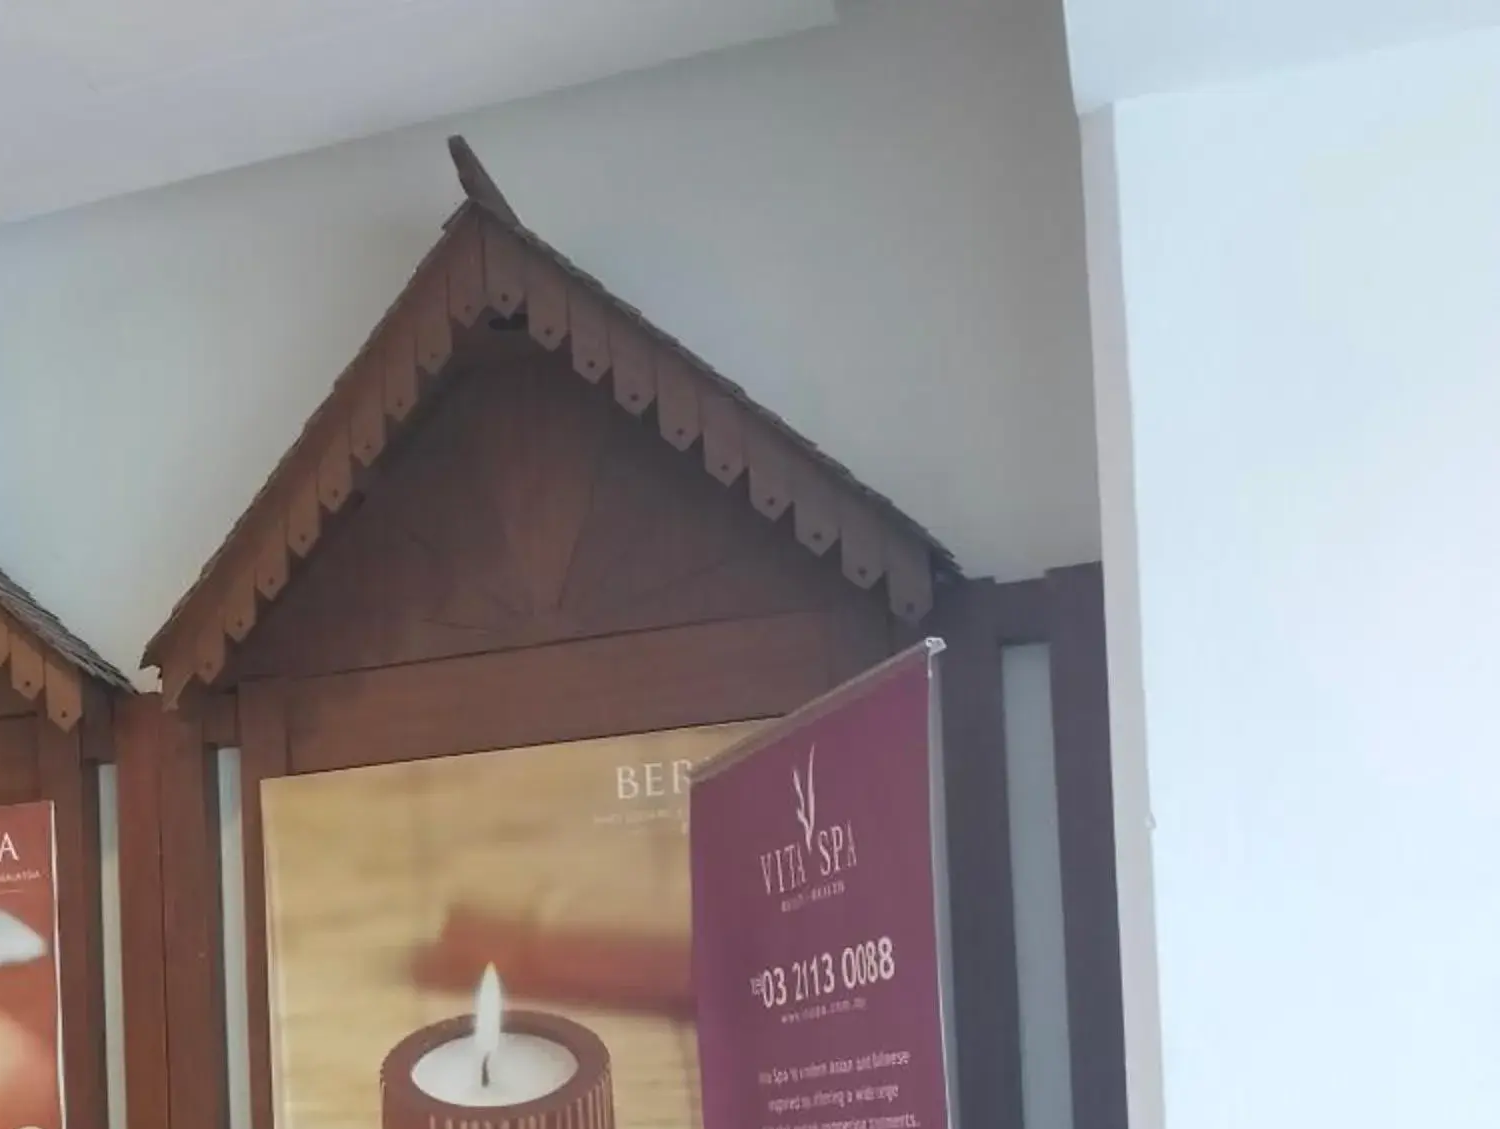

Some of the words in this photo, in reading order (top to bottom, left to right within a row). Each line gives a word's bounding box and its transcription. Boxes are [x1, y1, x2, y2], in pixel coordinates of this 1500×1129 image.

[760, 842, 806, 896] VITA
[818, 820, 857, 876] SPA
[762, 966, 788, 1009] 03
[791, 951, 835, 1001] 2113
[841, 935, 895, 990] 0088
